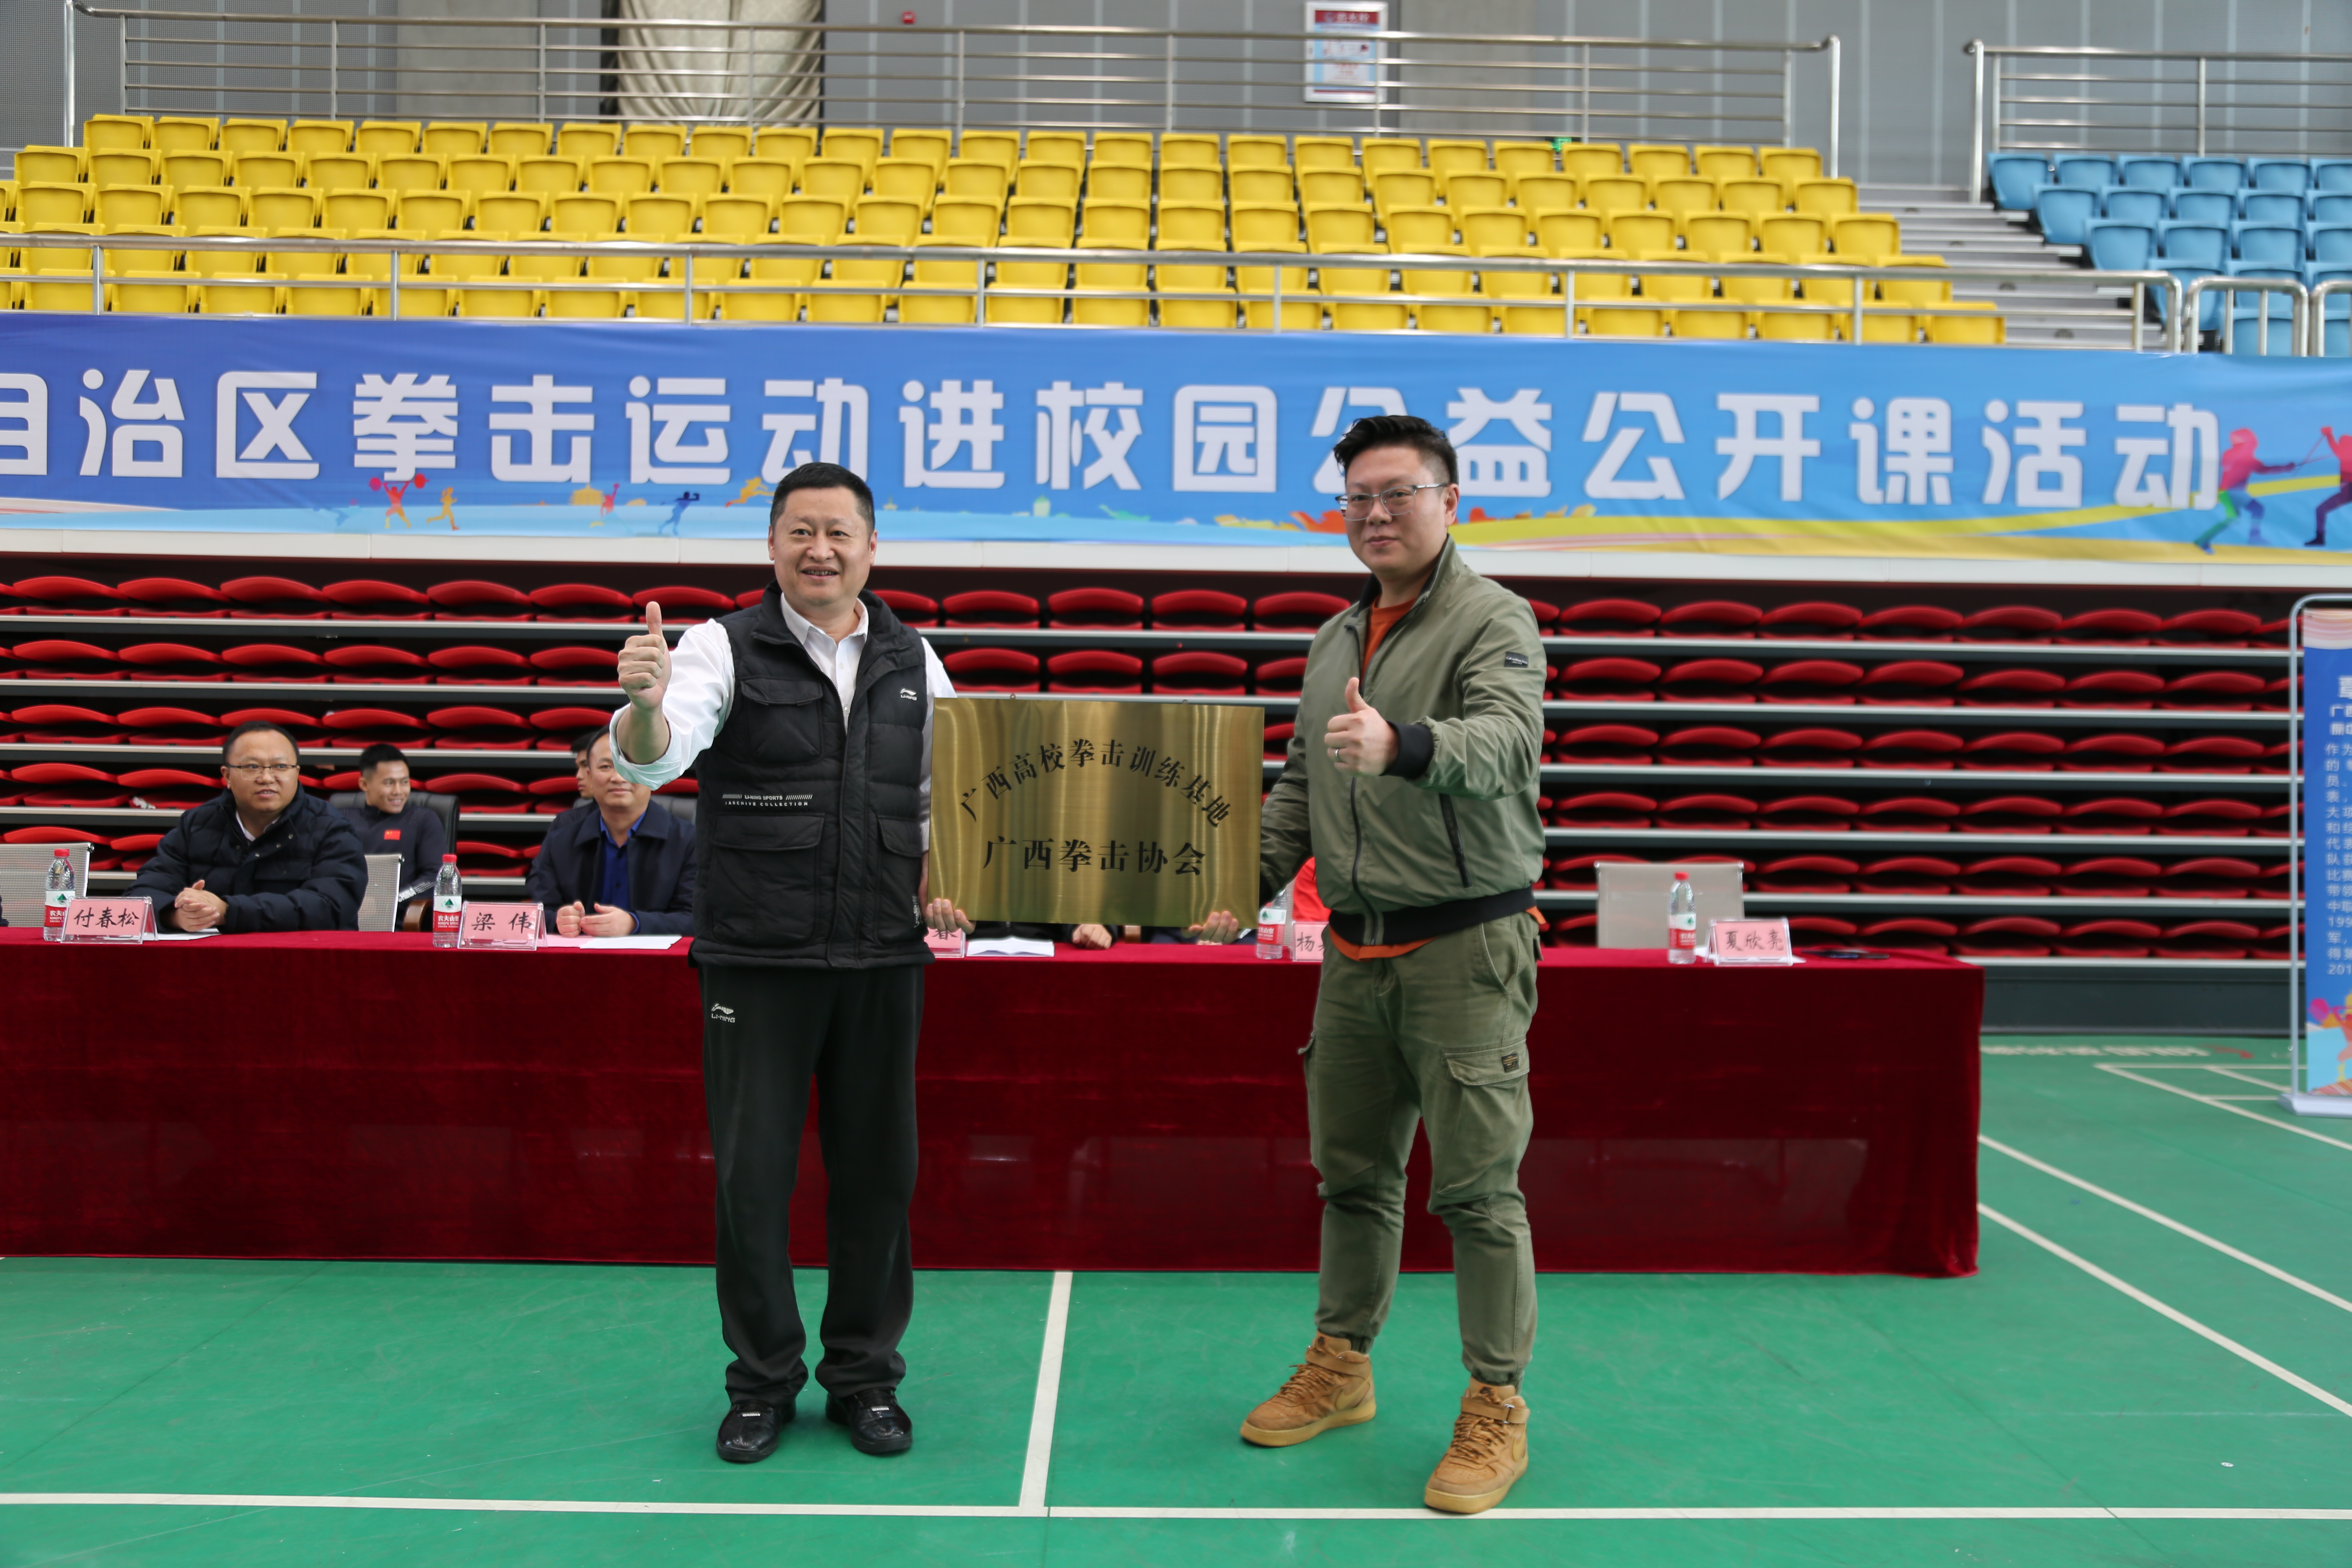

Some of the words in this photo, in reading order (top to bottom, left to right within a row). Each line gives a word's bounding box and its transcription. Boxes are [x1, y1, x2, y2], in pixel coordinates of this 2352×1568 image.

[960, 739, 1232, 828] 广西高校拳击训练基地
[983, 836, 1206, 876] 广西拳击协会
[74, 907, 140, 928] 付春松
[471, 912, 532, 933] 梁伟
[711, 1013, 735, 1023] LI-NING
